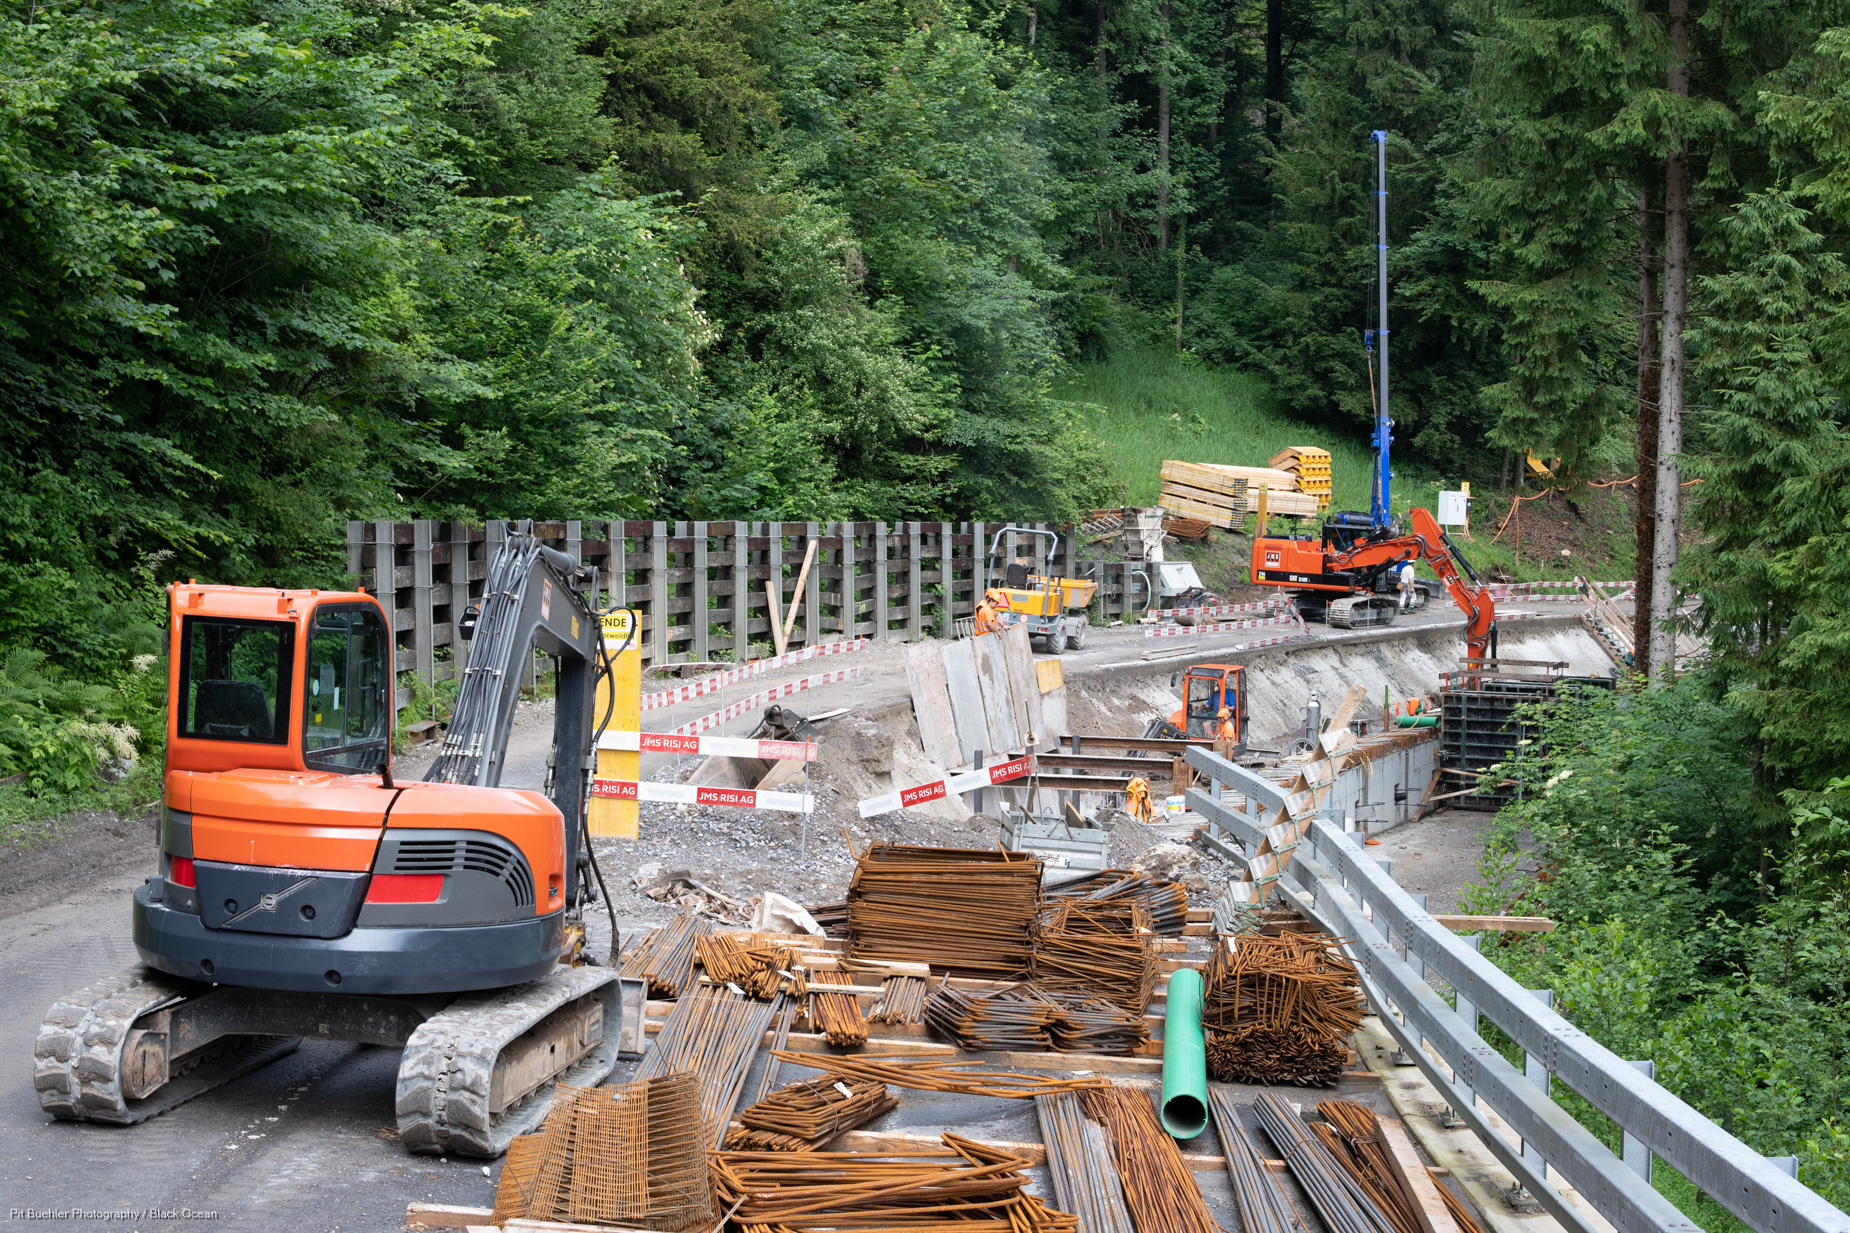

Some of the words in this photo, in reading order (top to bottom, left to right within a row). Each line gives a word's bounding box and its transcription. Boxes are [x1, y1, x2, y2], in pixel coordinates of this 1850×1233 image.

[600, 618, 626, 627] ENDE
[642, 738, 661, 747] JMS
[663, 739, 681, 748] RISI
[682, 741, 697, 749] AG
[761, 745, 780, 754] JMS
[991, 769, 1007, 779] JMS
[1007, 763, 1023, 775] RISI
[601, 785, 620, 794] RISI
[621, 786, 636, 795] AG
[903, 791, 918, 803] JMS
[918, 788, 932, 799] RISI
[933, 784, 945, 794] AG
[699, 792, 718, 802] JMS
[720, 793, 738, 803] RISI
[739, 795, 754, 804] AG
